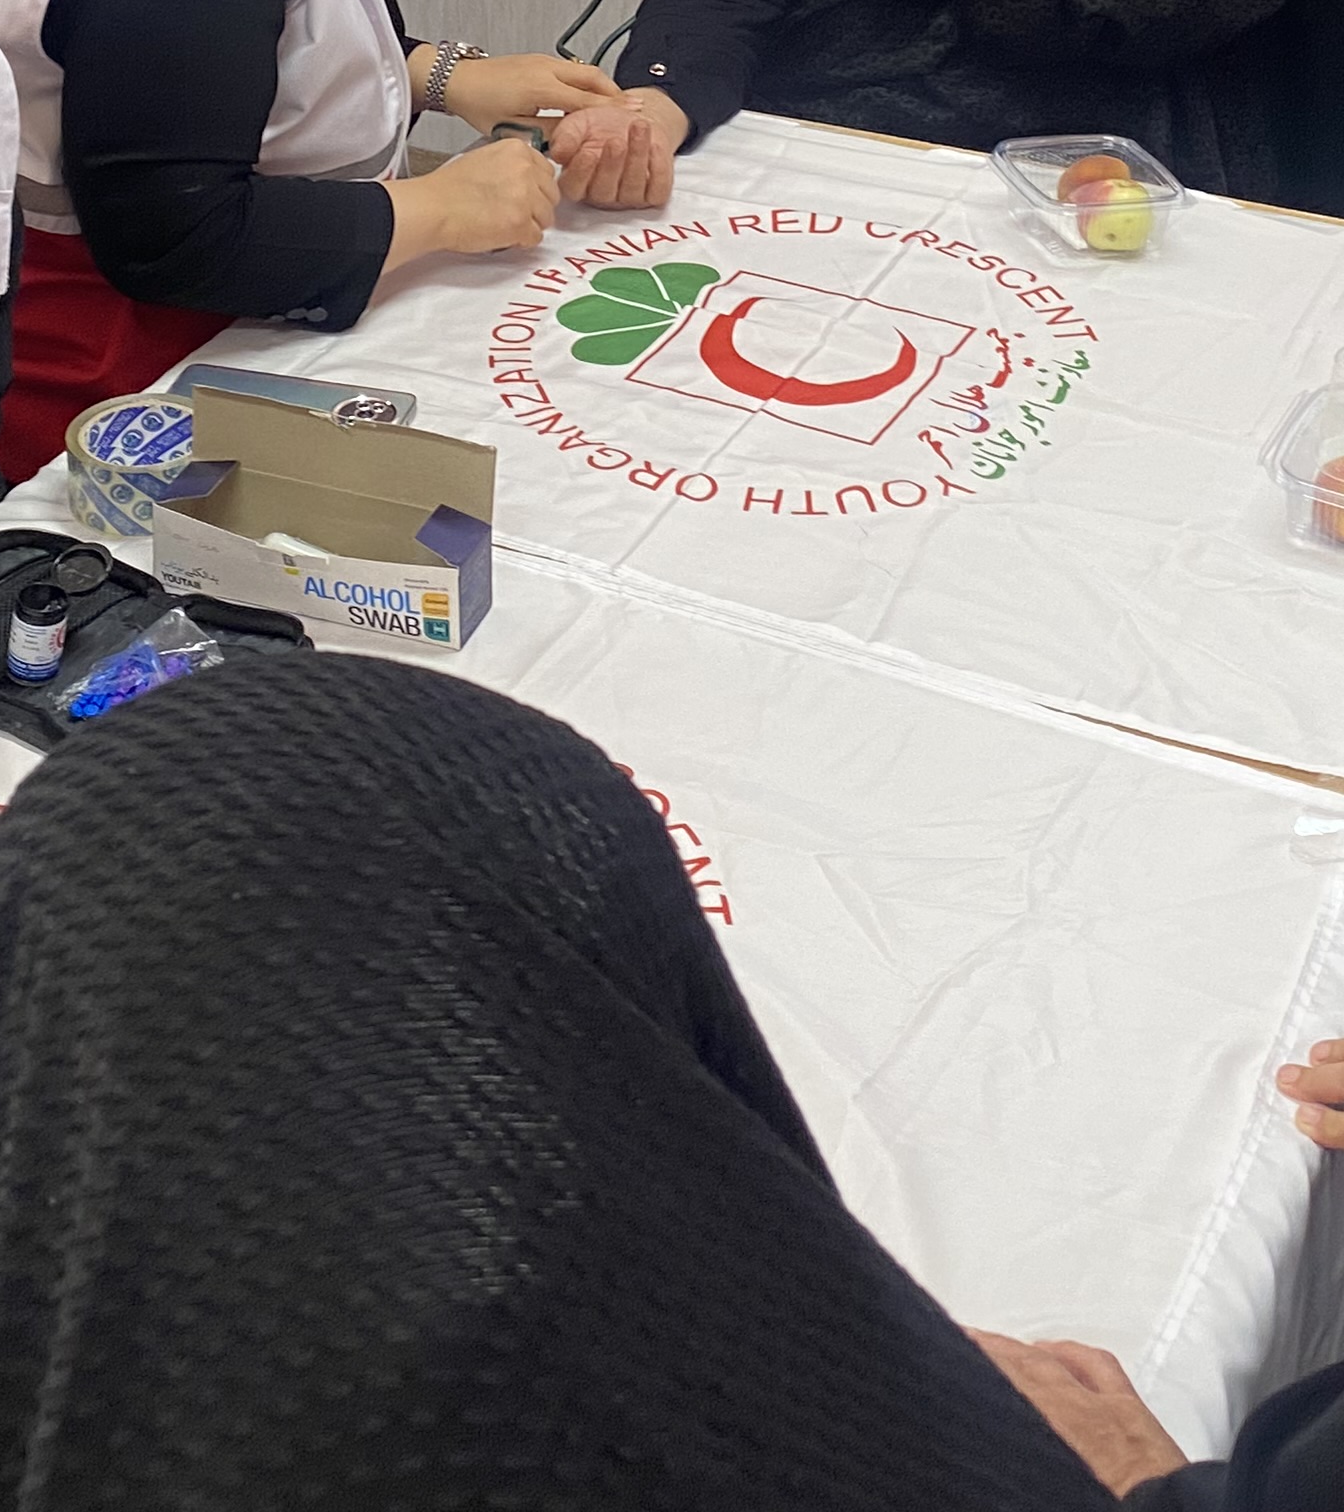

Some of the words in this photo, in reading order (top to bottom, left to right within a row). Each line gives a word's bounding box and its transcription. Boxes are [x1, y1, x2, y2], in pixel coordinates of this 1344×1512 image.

[864, 220, 1099, 342] CRESCENT
[985, 327, 1037, 389] جمعیت
[488, 301, 719, 502] ORGANIZATION
[927, 384, 991, 434] هلال
[917, 424, 961, 471] احمر
[742, 474, 977, 516] YOUTH
[304, 576, 421, 616] ALCOHOL
[348, 605, 421, 637] SWAB
